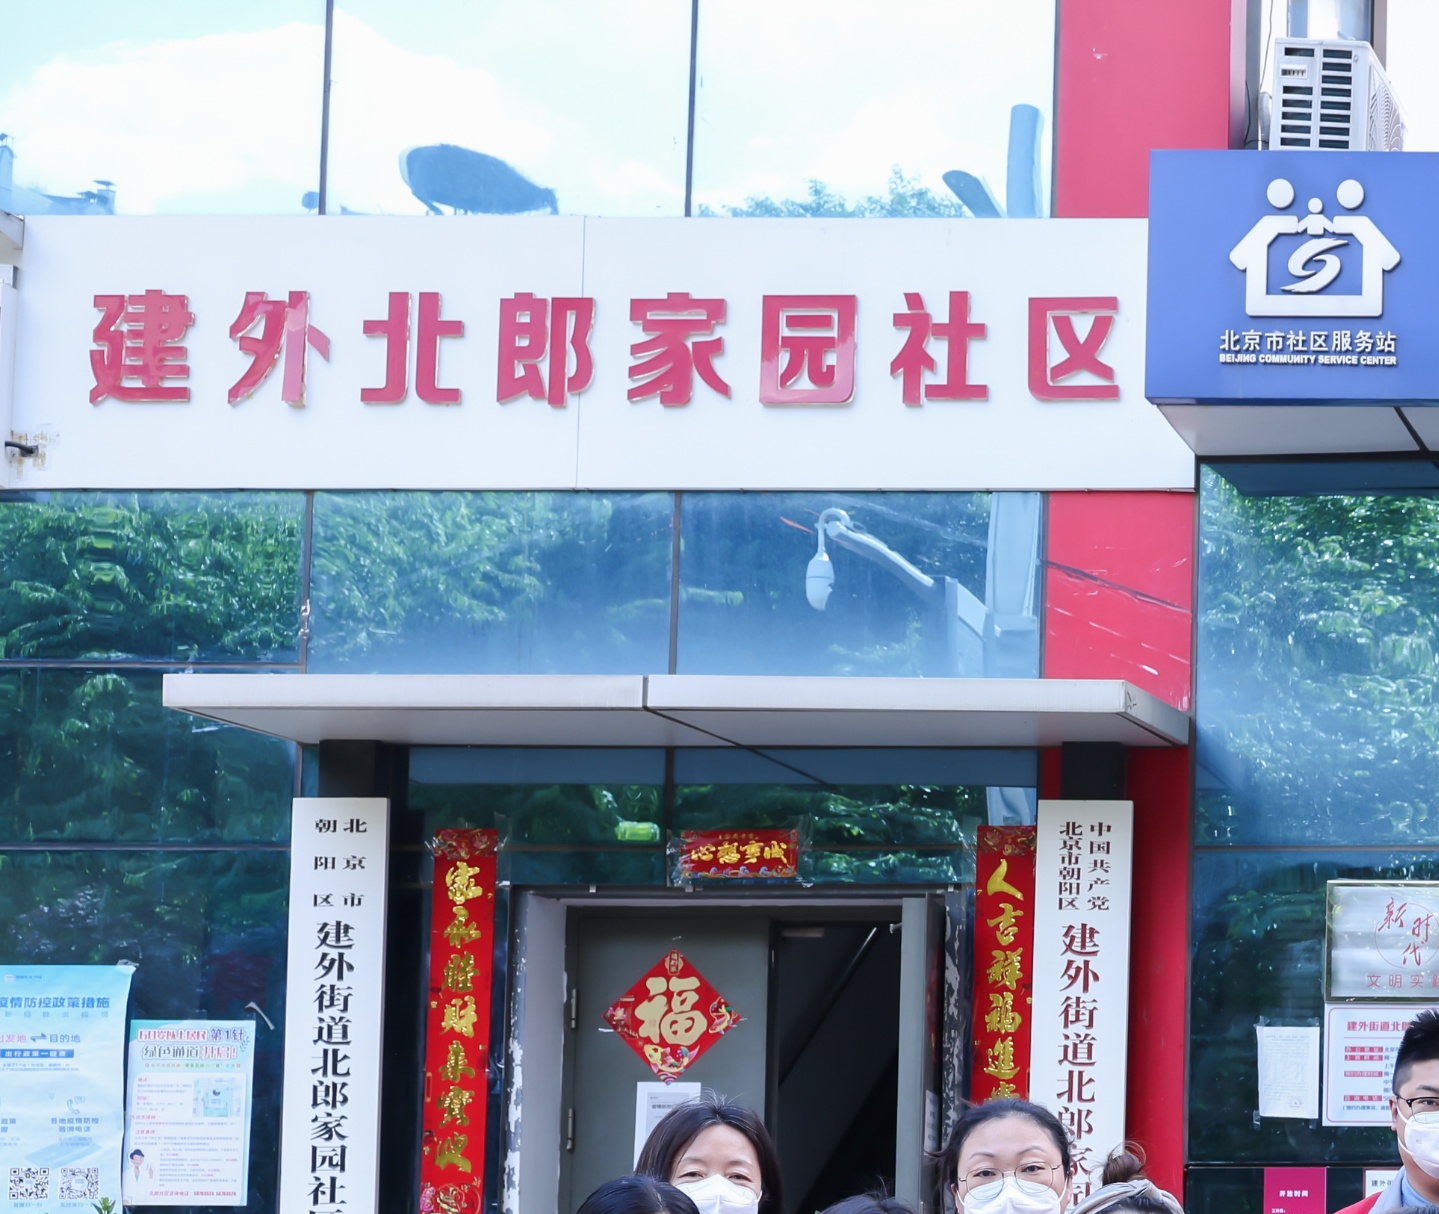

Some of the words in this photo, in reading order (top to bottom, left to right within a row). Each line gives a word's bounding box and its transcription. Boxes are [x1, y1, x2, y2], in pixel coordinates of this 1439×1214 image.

[89, 289, 1122, 408] 建外北郎家园社区
[1219, 329, 1397, 353] 北京市社区服务站
[1219, 353, 1256, 364] BEIJING
[1259, 354, 1316, 364] COMMUNITY
[1318, 354, 1358, 365] SERVICE
[1360, 355, 1397, 366] CENTER
[312, 818, 338, 908] 朝阳区
[342, 818, 368, 908] 北京市
[1058, 822, 1083, 911] 北京市朝阳区
[1087, 822, 1113, 911] 中国共产党
[634, 976, 708, 1046] 福
